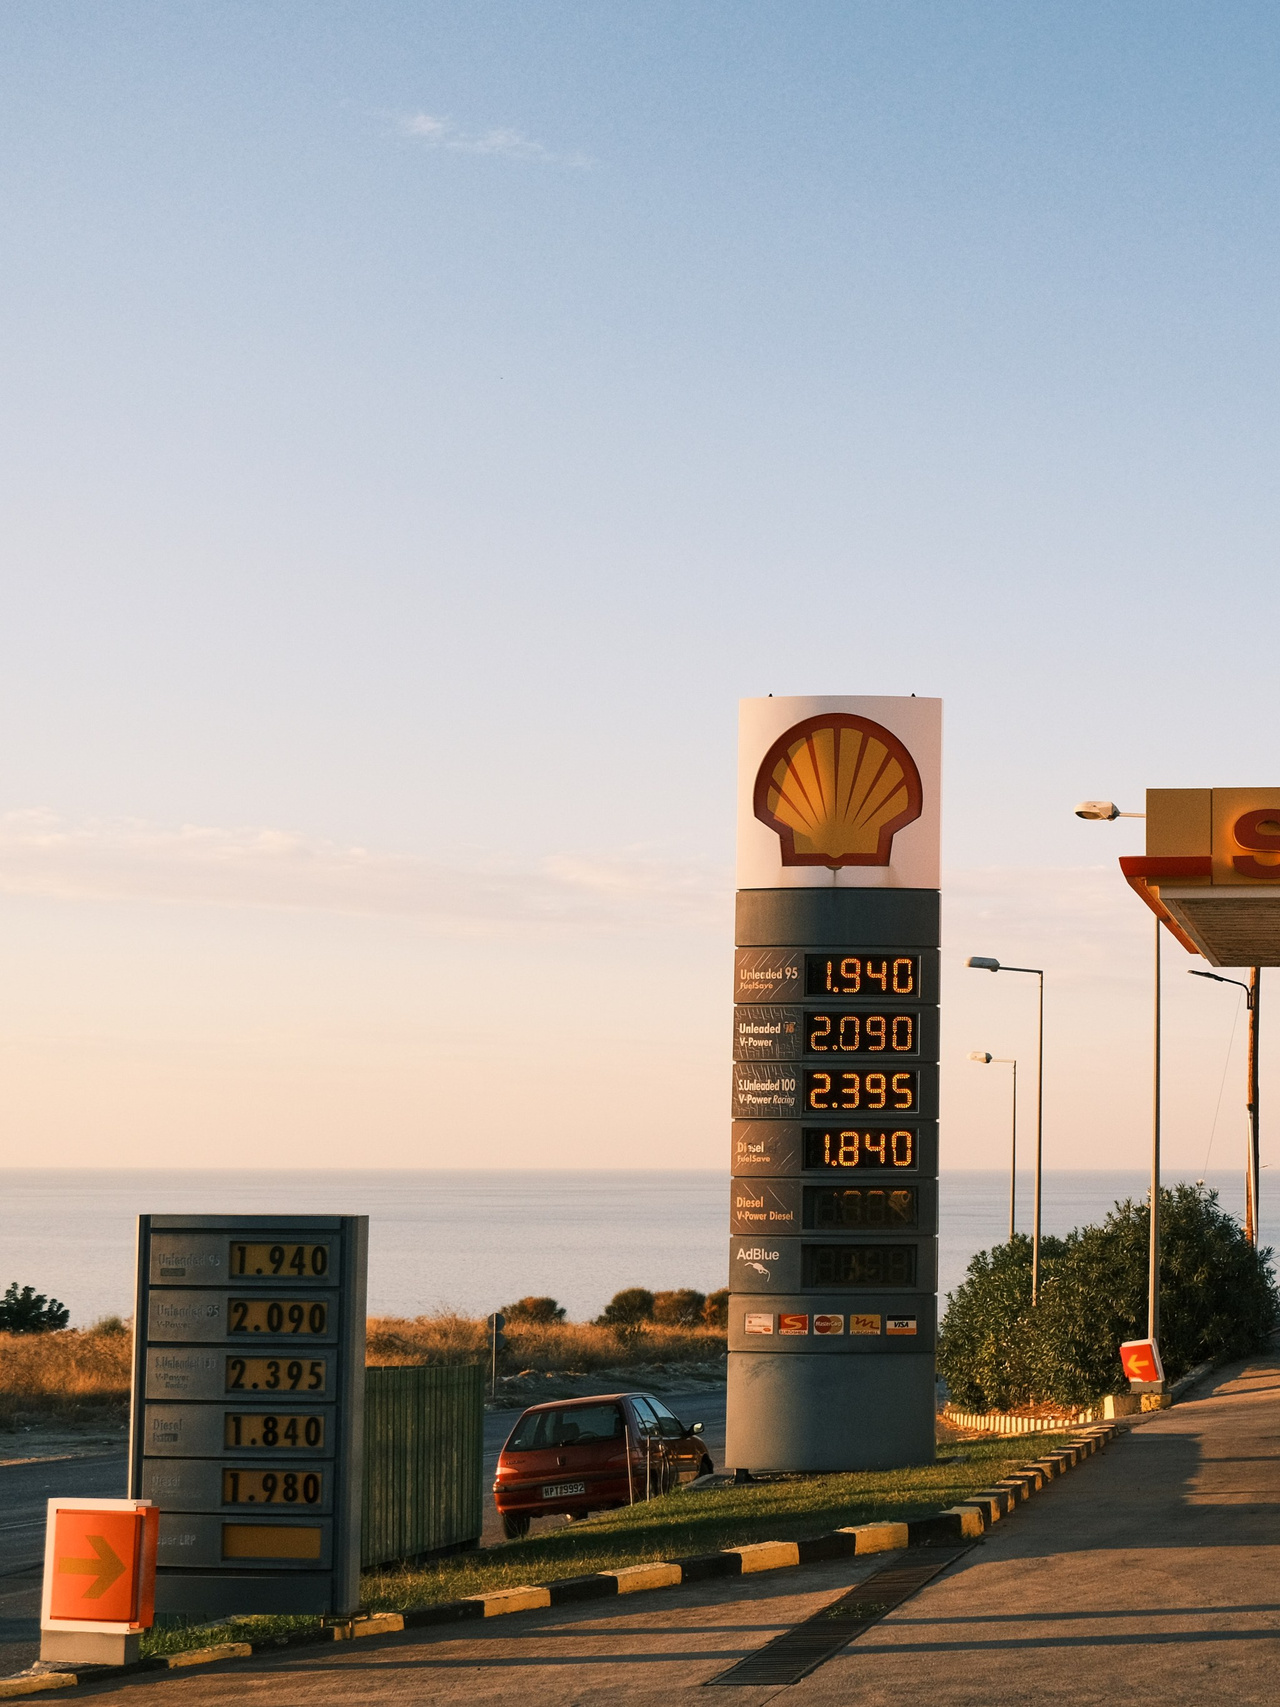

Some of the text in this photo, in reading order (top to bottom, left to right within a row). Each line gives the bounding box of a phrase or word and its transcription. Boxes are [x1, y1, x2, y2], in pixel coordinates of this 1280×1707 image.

[785, 966, 798, 980] 95
[826, 958, 914, 994] 1.940
[739, 1022, 781, 1034] Unleaded
[810, 1016, 914, 1051] 2.090
[739, 1037, 773, 1047] V-Power
[738, 1079, 796, 1092] S.Unleaded 100
[810, 1073, 913, 1109] 2.395
[738, 1095, 795, 1107] V-Power Racing
[824, 1131, 912, 1167] 1.840
[737, 1155, 771, 1163] FuelSave
[736, 1196, 764, 1209] Diesel
[736, 1210, 794, 1221] V-Power Diesel
[208, 1254, 222, 1268] 95
[236, 1245, 328, 1276] 1.940
[736, 1248, 780, 1261] AdBlue
[207, 1304, 221, 1318] 95
[232, 1301, 327, 1334] 2.090
[230, 1358, 324, 1390] 2.395
[153, 1417, 183, 1432] Diesel
[232, 1415, 322, 1447] 1.840
[229, 1472, 321, 1504] 1.980
[563, 1483, 584, 1494] 9992
